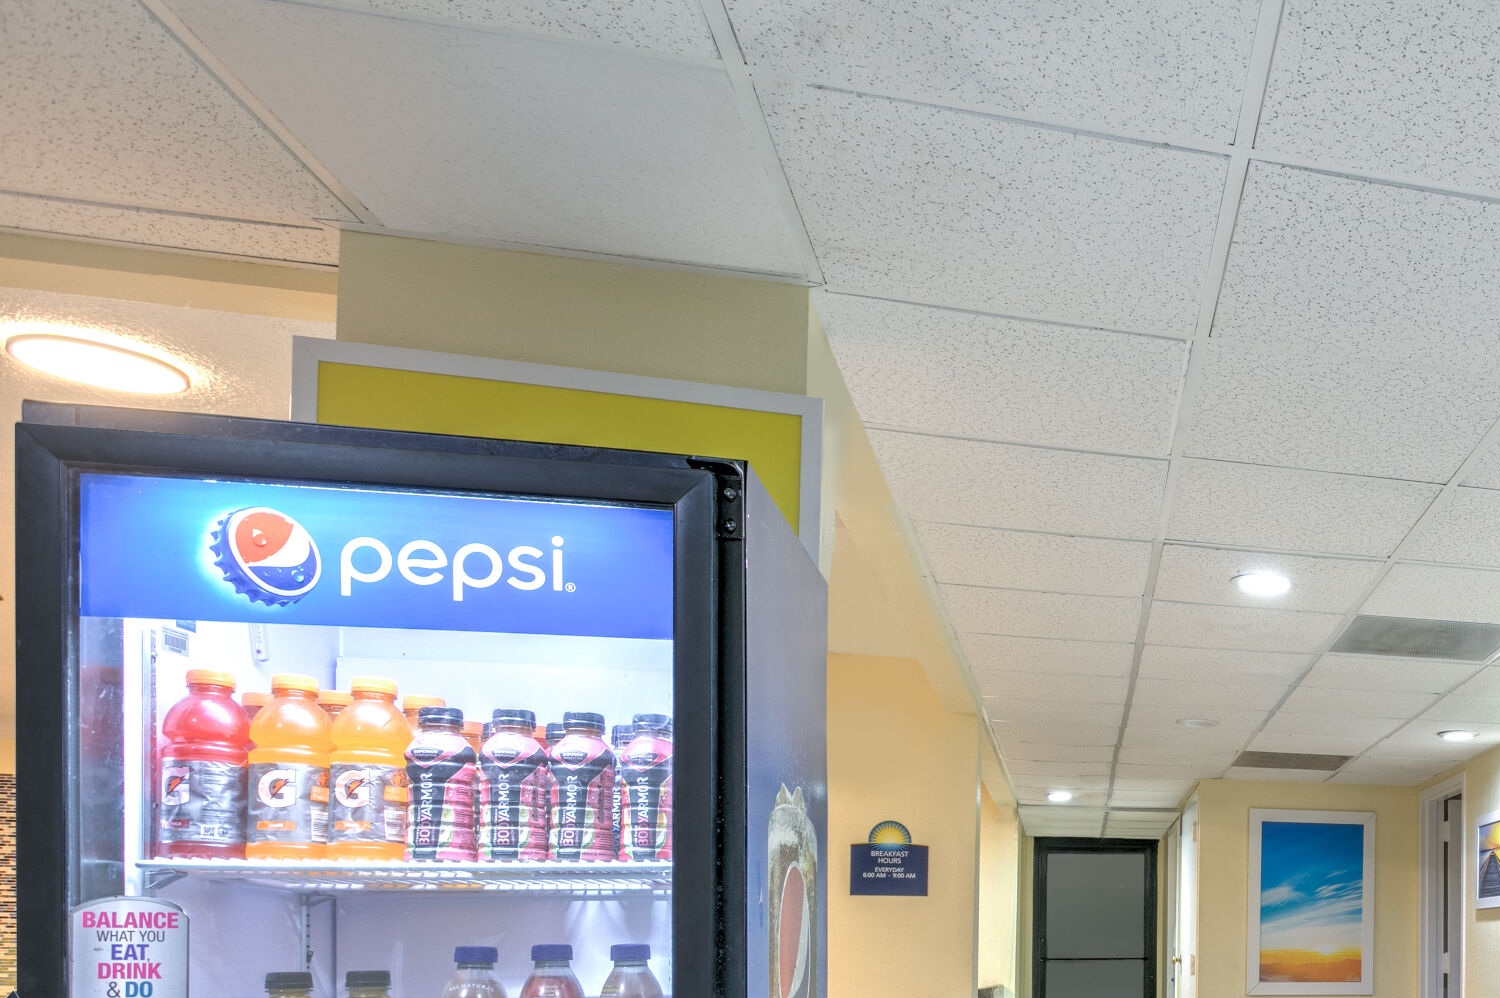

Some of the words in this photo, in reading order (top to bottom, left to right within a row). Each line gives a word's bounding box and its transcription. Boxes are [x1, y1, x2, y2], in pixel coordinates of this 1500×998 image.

[341, 535, 565, 602] pepsi
[258, 769, 297, 808] G
[335, 769, 370, 808] G
[82, 911, 179, 929] BALANCE
[96, 930, 135, 942] WHAT
[139, 930, 165, 942] YOU
[97, 962, 162, 979] DRINK
[106, 981, 121, 998] &
[125, 981, 153, 998] DO
